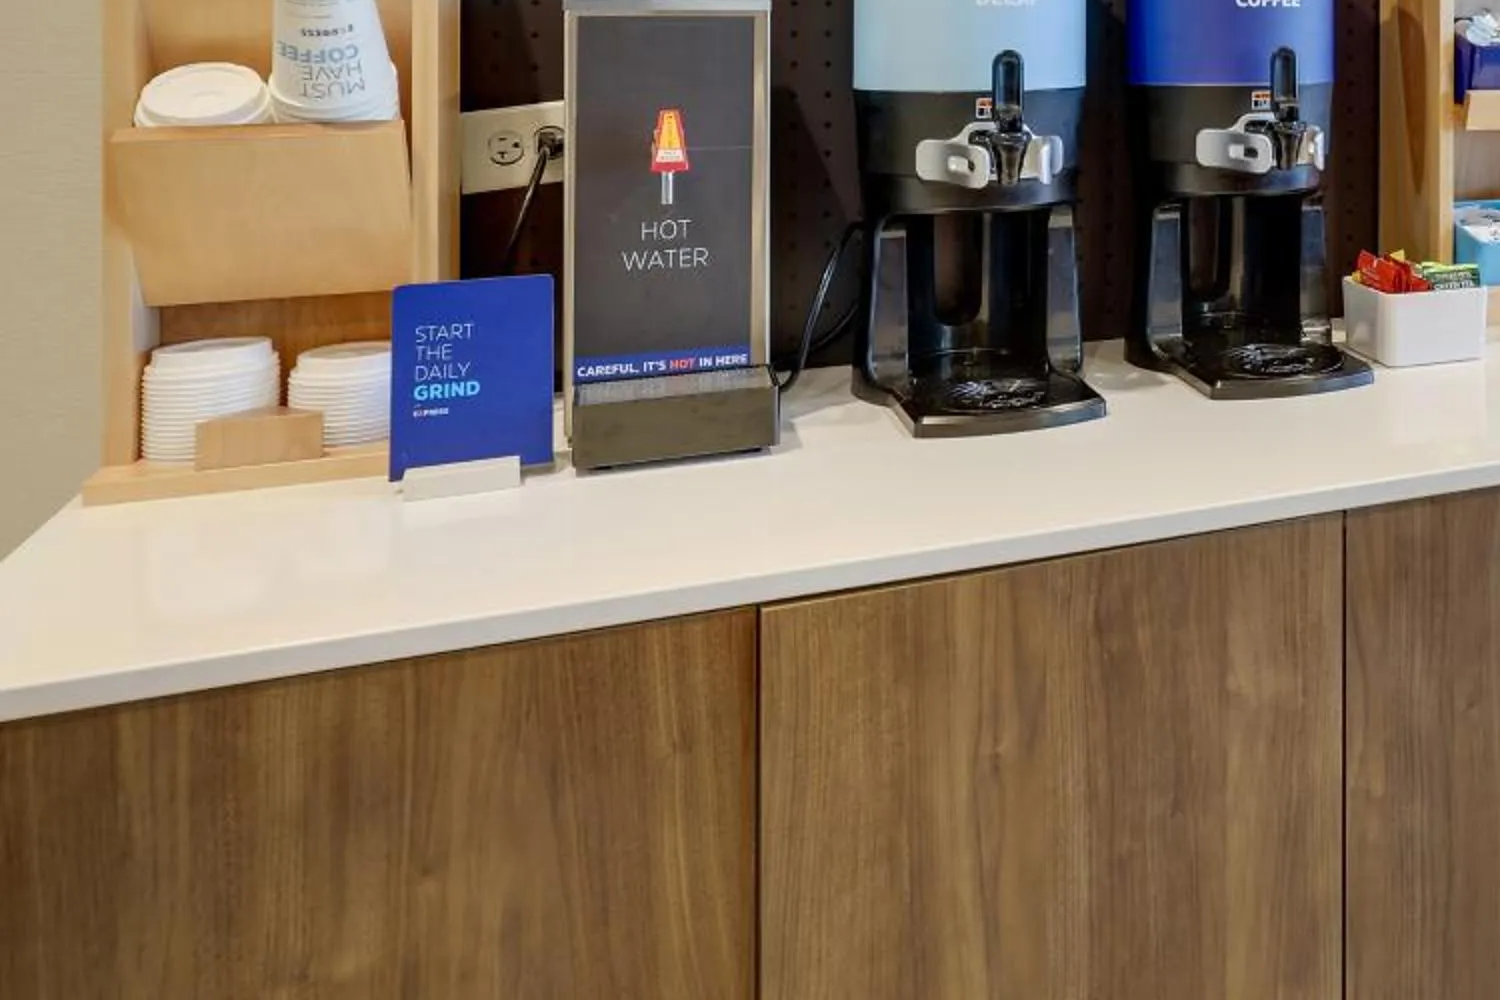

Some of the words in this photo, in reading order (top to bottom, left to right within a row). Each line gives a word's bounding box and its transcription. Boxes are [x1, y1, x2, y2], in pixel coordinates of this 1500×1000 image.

[301, 61, 363, 82] HAVE
[640, 219, 692, 241] HOT
[622, 247, 709, 271] WATER
[415, 323, 474, 343] START
[416, 343, 453, 361] THE
[415, 362, 471, 382] DAILY
[643, 359, 667, 373] IT'S
[669, 357, 697, 370] HOT
[699, 355, 713, 367] IN
[715, 353, 749, 366] HERE
[413, 381, 481, 401] GRIND
